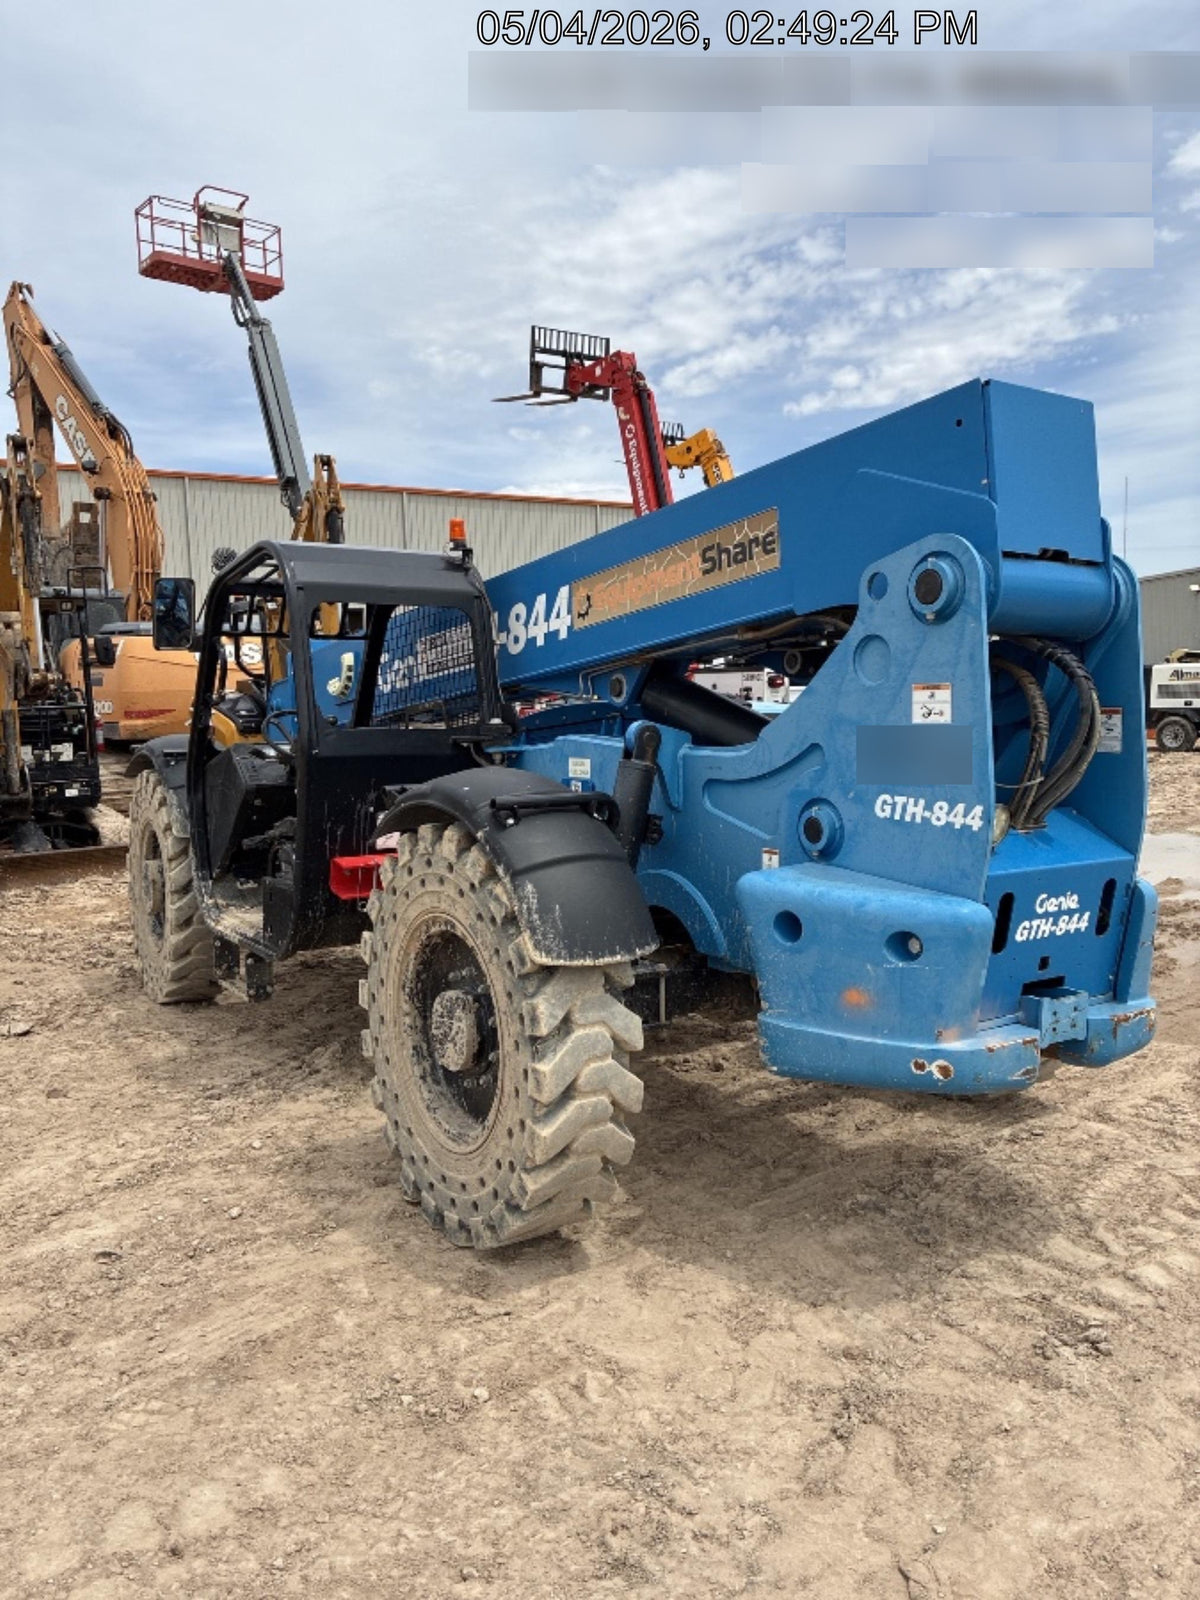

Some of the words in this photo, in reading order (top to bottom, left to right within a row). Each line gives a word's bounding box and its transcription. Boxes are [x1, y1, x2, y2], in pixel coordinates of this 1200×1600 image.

[874, 793, 984, 832] GTH-844
[1035, 890, 1080, 914] Genie
[1015, 911, 1091, 942] GTH-844
